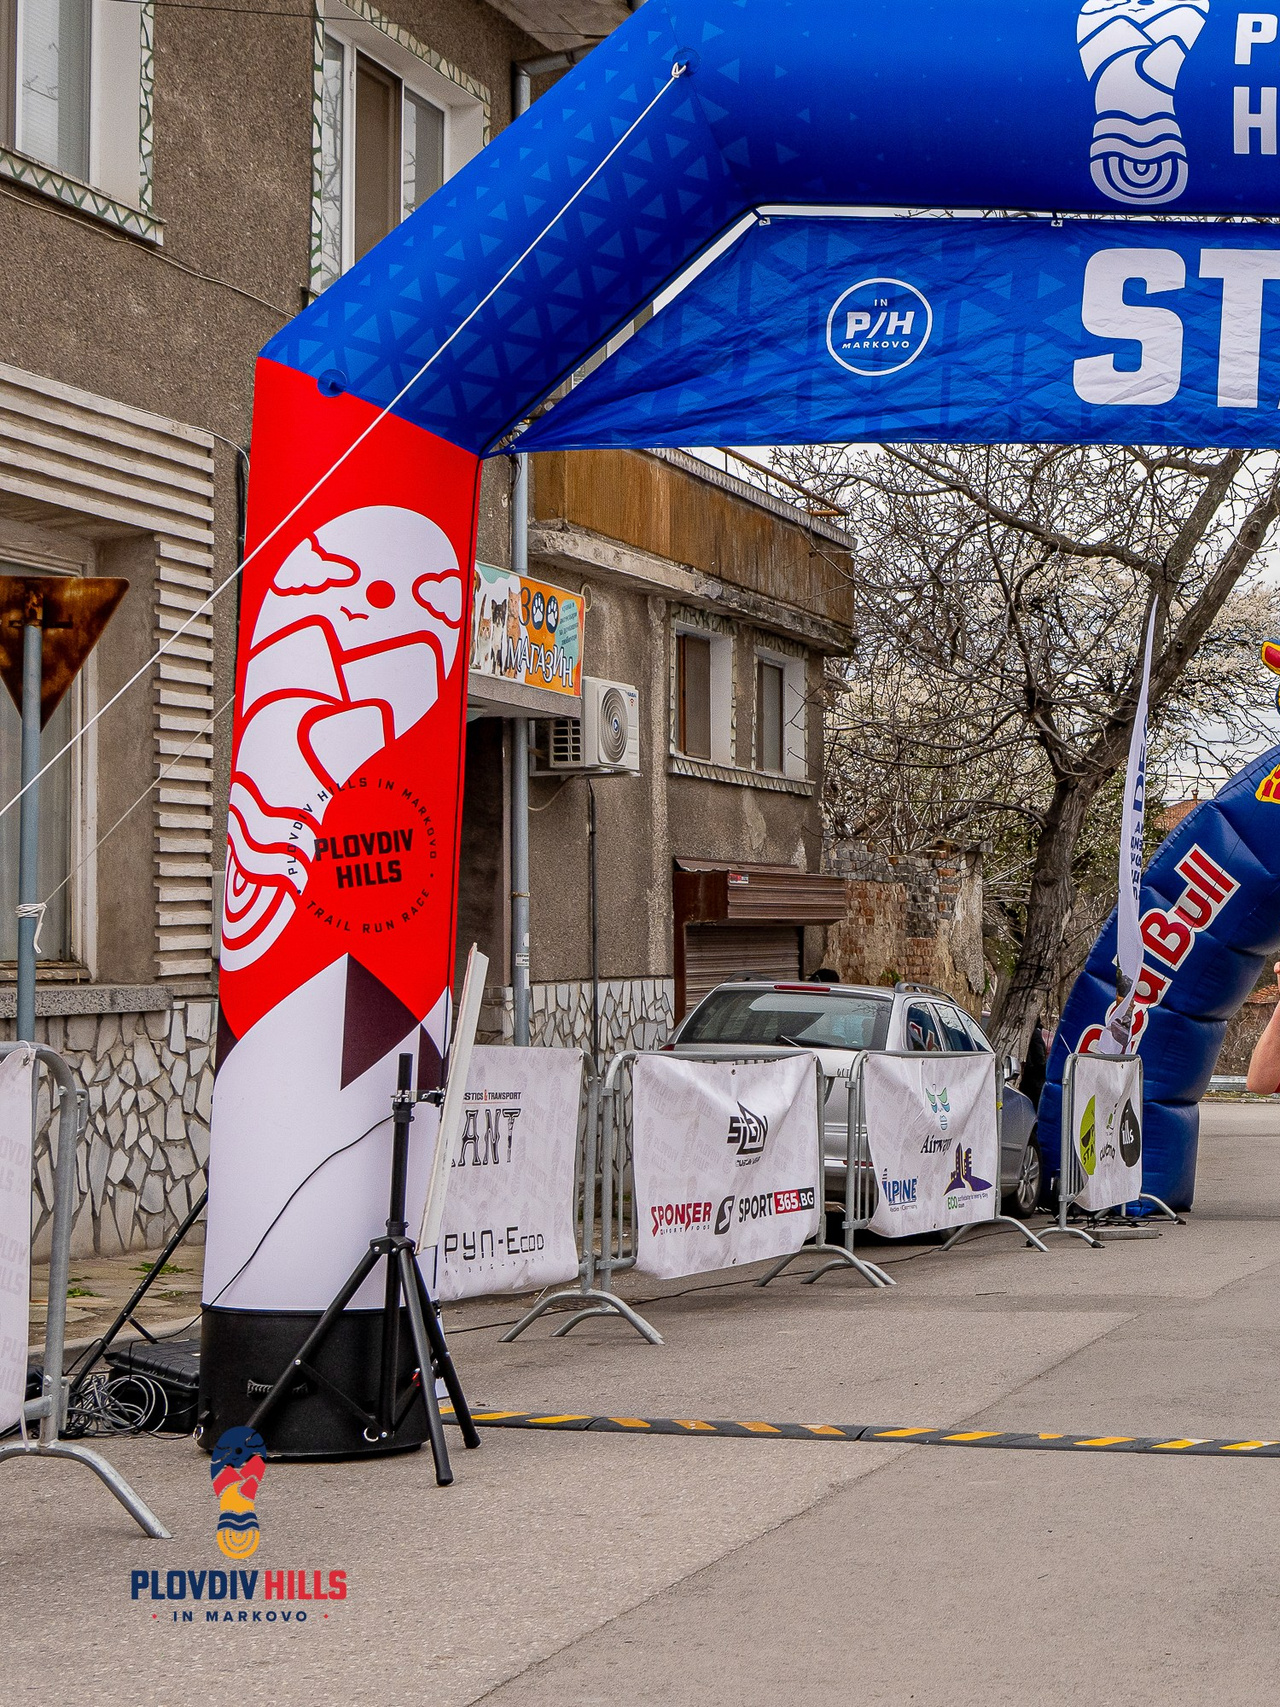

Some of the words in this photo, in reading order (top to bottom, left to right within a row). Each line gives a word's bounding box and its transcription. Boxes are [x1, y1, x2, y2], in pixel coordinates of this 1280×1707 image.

[873, 298, 888, 307] IN
[845, 311, 916, 340] P/H
[841, 340, 911, 350] MARKOVO
[506, 635, 574, 688] МАГАЗИН
[287, 803, 313, 876] PLOVDIV
[317, 777, 368, 802] HILLS
[378, 778, 395, 791] IN
[401, 788, 437, 859] MARKOVO
[314, 828, 414, 862] PLOVDIV
[335, 859, 403, 889] HILLS
[306, 901, 351, 932] TRAIL
[362, 919, 395, 934] RUN
[401, 888, 430, 923] RACE
[1140, 846, 1239, 969] Bull
[487, 1092, 521, 1100] TRANSPORT
[650, 1201, 712, 1237] SPONSER
